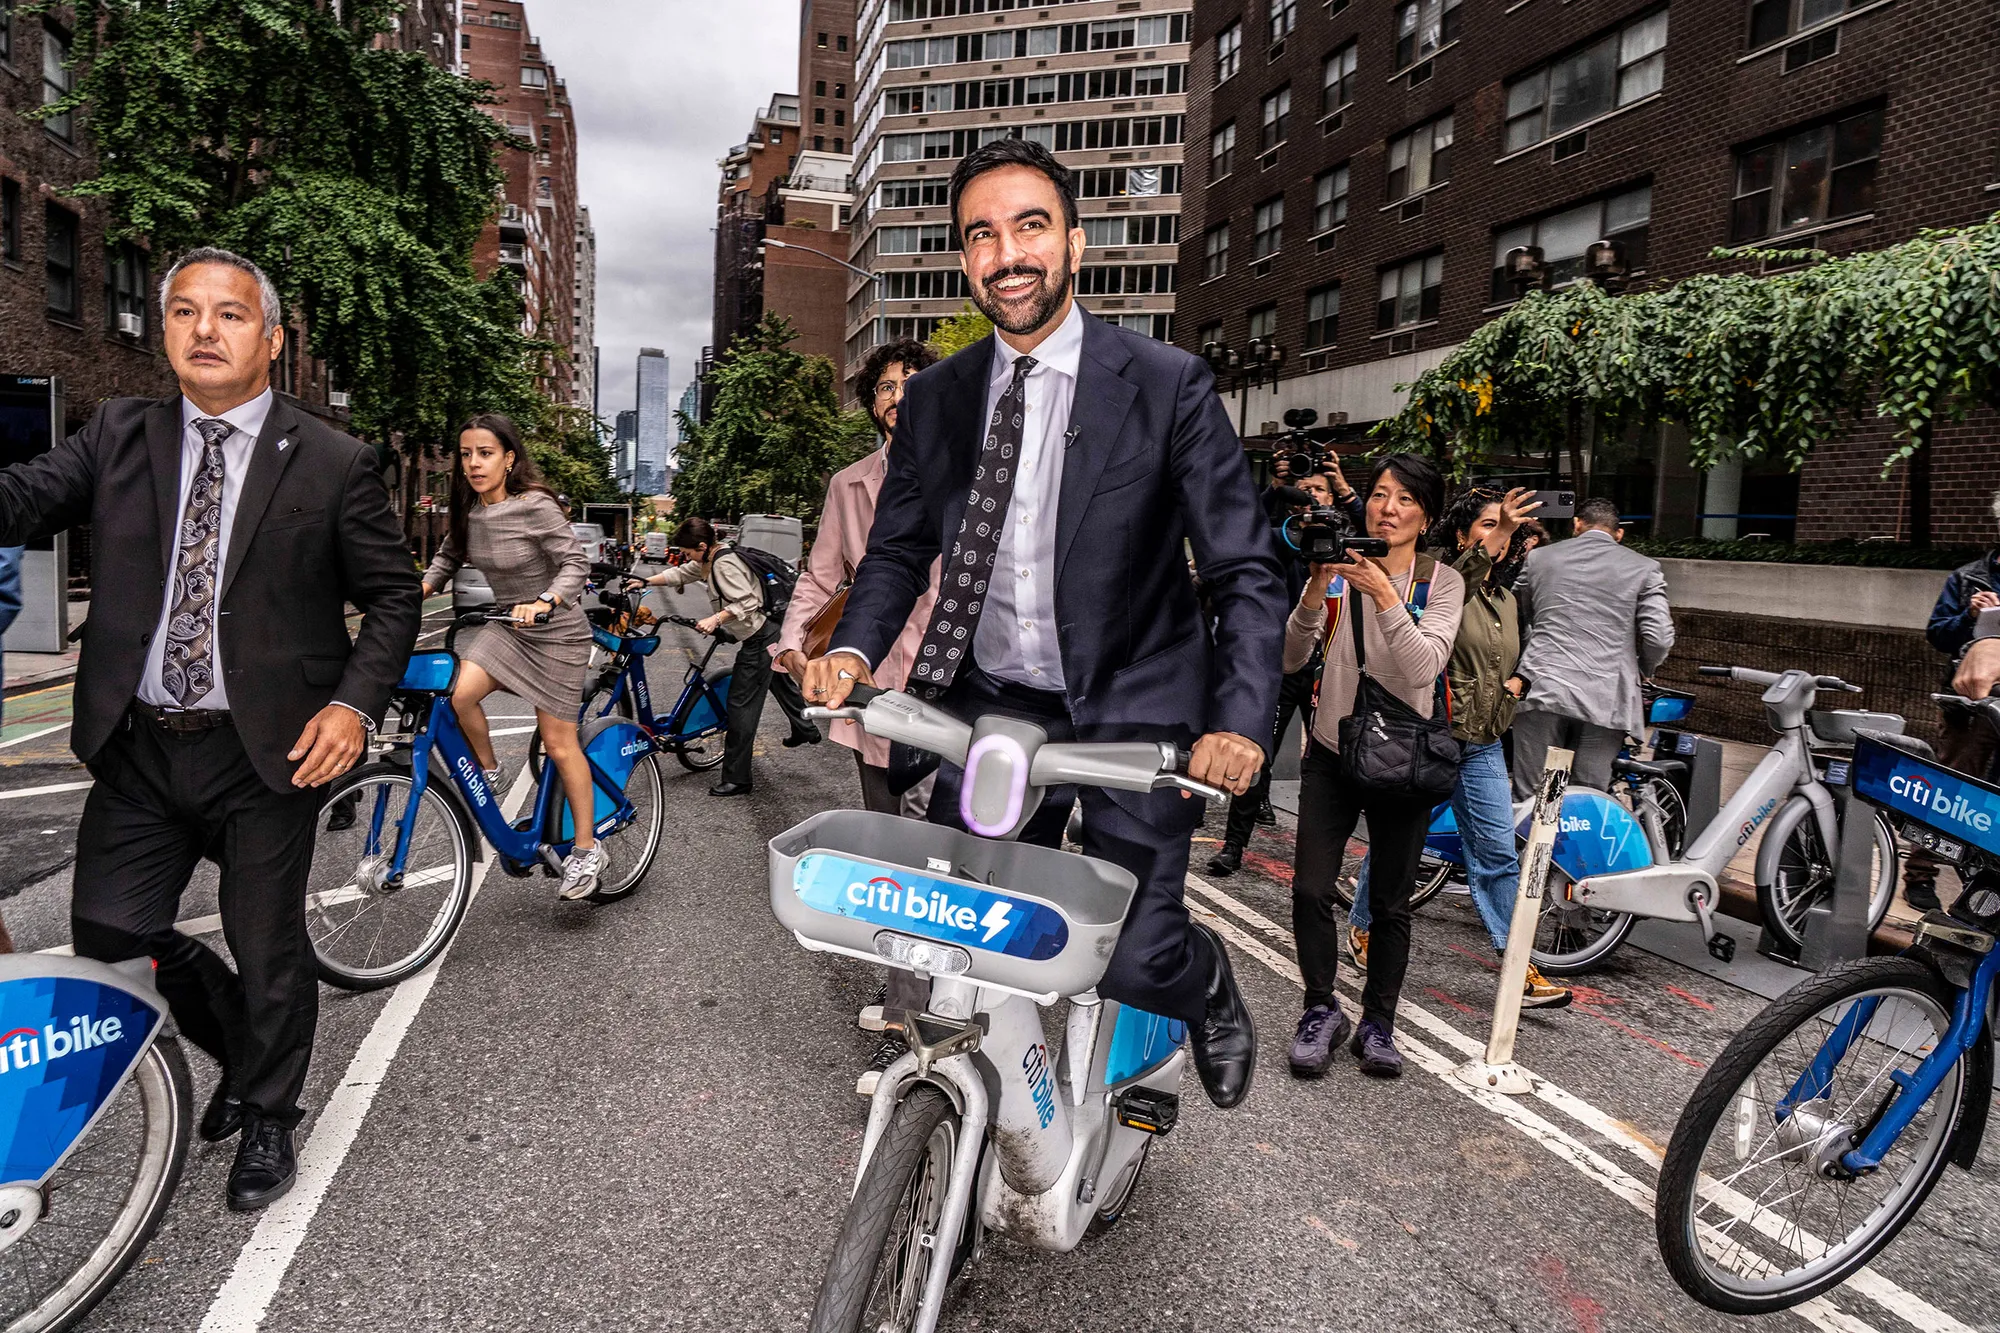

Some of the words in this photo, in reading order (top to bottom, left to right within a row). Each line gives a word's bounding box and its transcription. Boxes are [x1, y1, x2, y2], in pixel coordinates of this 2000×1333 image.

[457, 756, 475, 780] citi
[468, 774, 488, 807] bike
[1889, 775, 1932, 806] citi
[1931, 787, 1992, 832] bike
[1559, 816, 1591, 833] bike
[1737, 821, 1755, 845] citi
[1751, 798, 1776, 825] bike
[847, 877, 903, 914] citi
[904, 886, 978, 932] bike
[0, 1028, 40, 1074] iti
[43, 1014, 124, 1061] bike
[1022, 1043, 1046, 1090] citi
[1032, 1066, 1055, 1129] bike
